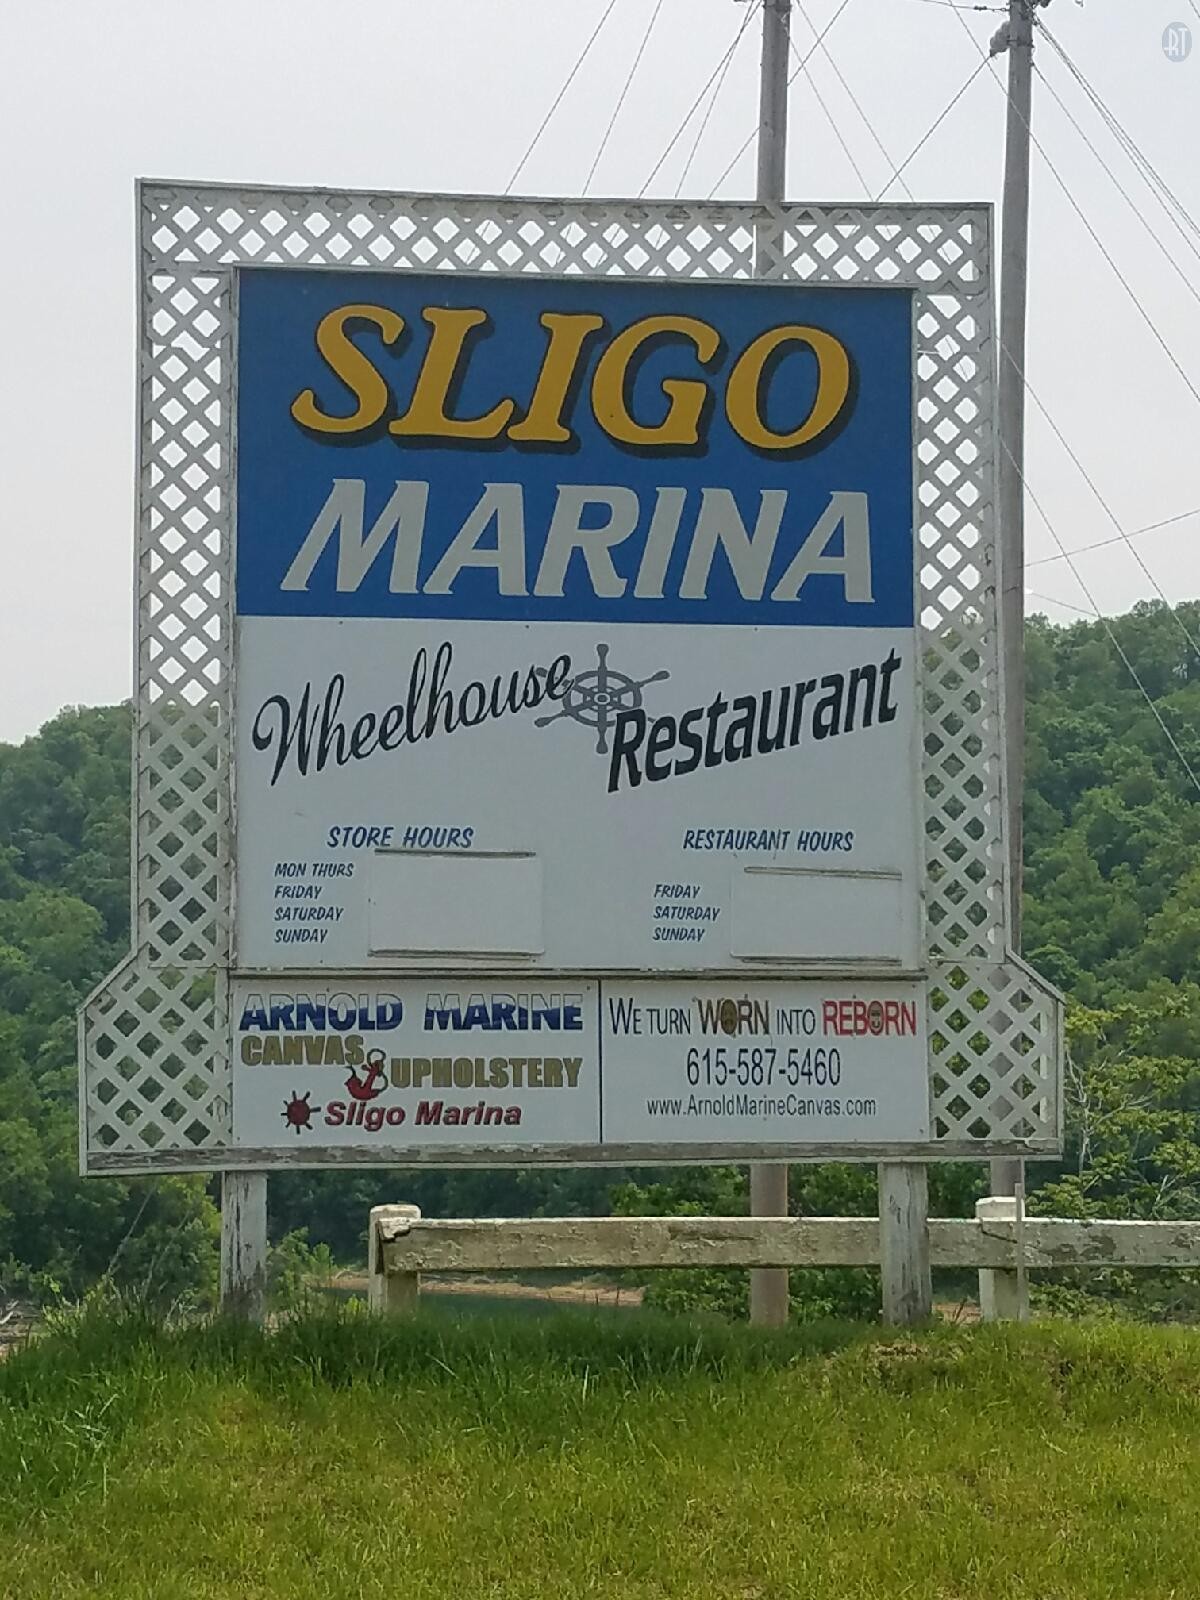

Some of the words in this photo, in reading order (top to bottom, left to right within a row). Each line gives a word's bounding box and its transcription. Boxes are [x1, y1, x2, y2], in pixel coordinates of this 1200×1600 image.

[291, 304, 857, 460] SLIGO
[280, 478, 876, 604] MARINA
[252, 641, 574, 786] Wheelhouse
[607, 647, 902, 793] Restaurant
[327, 827, 392, 848] STORE
[403, 826, 474, 849] HOURS
[683, 829, 790, 852] RESTAURANT
[797, 830, 854, 852] HOURS
[274, 862, 307, 877] MON
[310, 863, 354, 877] THURS
[274, 883, 322, 899] FRIDAY
[653, 883, 701, 899] FRIDAY
[274, 905, 343, 921] SATURDAY
[653, 905, 720, 921] SATURDAY
[274, 928, 328, 943] SUNDAY
[653, 926, 705, 942] SUNDAY
[239, 992, 403, 1031] ARNOLD
[423, 993, 583, 1030] MARINE
[646, 1007, 692, 1035] TURN
[776, 1008, 816, 1035] INTO
[823, 1000, 917, 1036] REBORN
[240, 1034, 364, 1066] CANVAS
[390, 1057, 583, 1088] UPHOLSTERY
[686, 1047, 841, 1086] 615-587-5460
[324, 1101, 406, 1132] Sligo
[414, 1101, 522, 1126] Marina
[647, 1093, 877, 1117] www.ArnoldMarineCanvas.com
